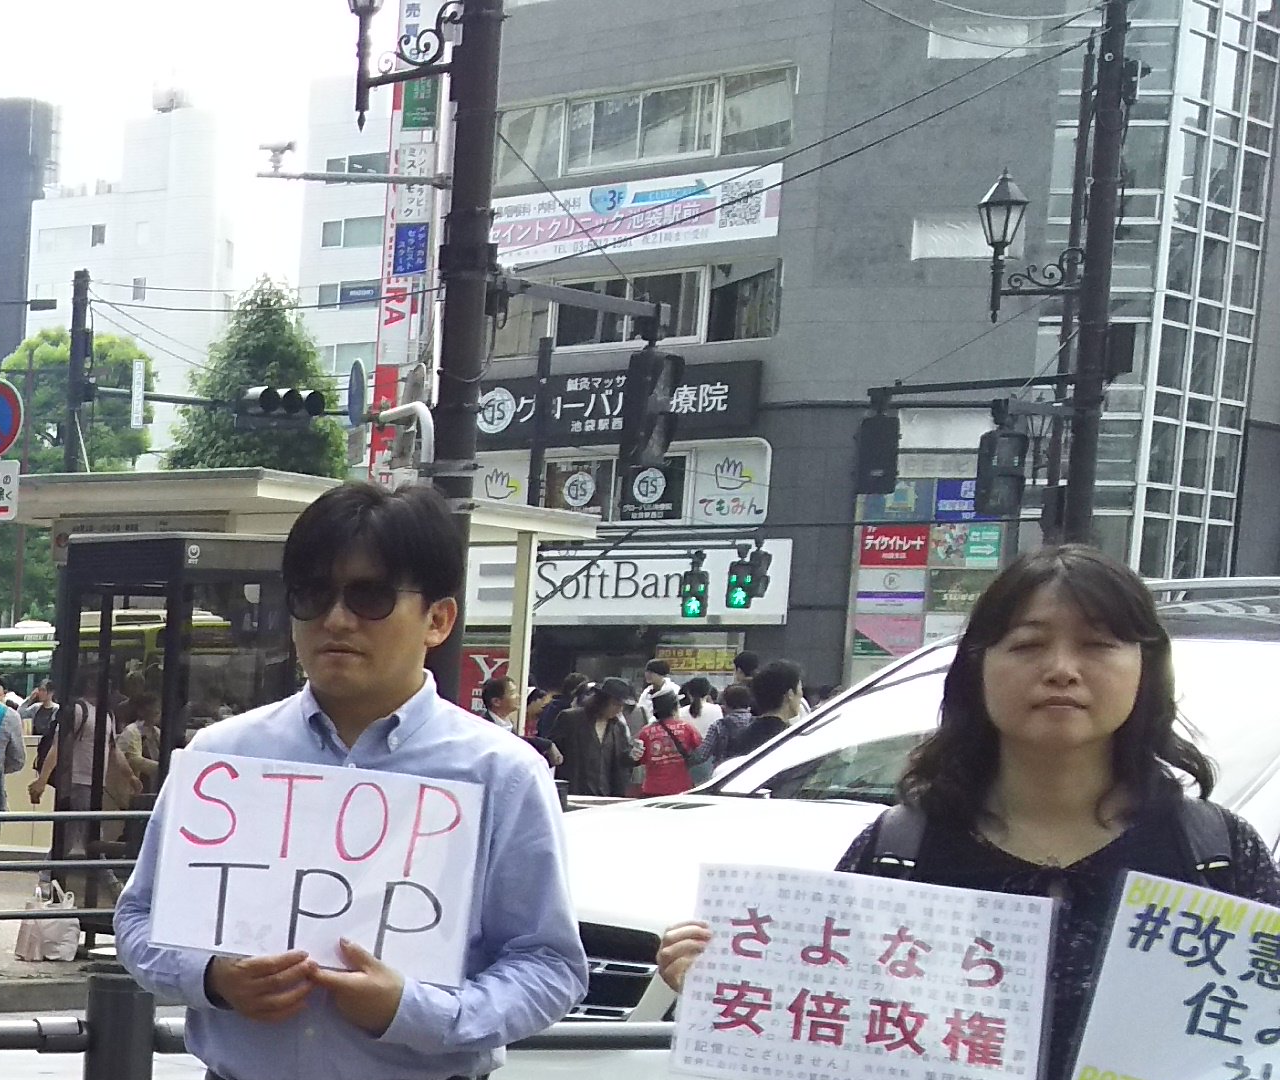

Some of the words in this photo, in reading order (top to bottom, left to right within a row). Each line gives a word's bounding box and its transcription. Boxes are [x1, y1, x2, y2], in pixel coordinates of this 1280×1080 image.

[566, 375, 628, 391] 鍼灸マッサ
[570, 417, 624, 432] 池袋駅西
[535, 560, 686, 600] SoftBan
[179, 760, 462, 878] STOP
[188, 862, 442, 961] TPP
[730, 906, 1005, 989] さよなら
[713, 980, 1007, 1066] 安倍政権
